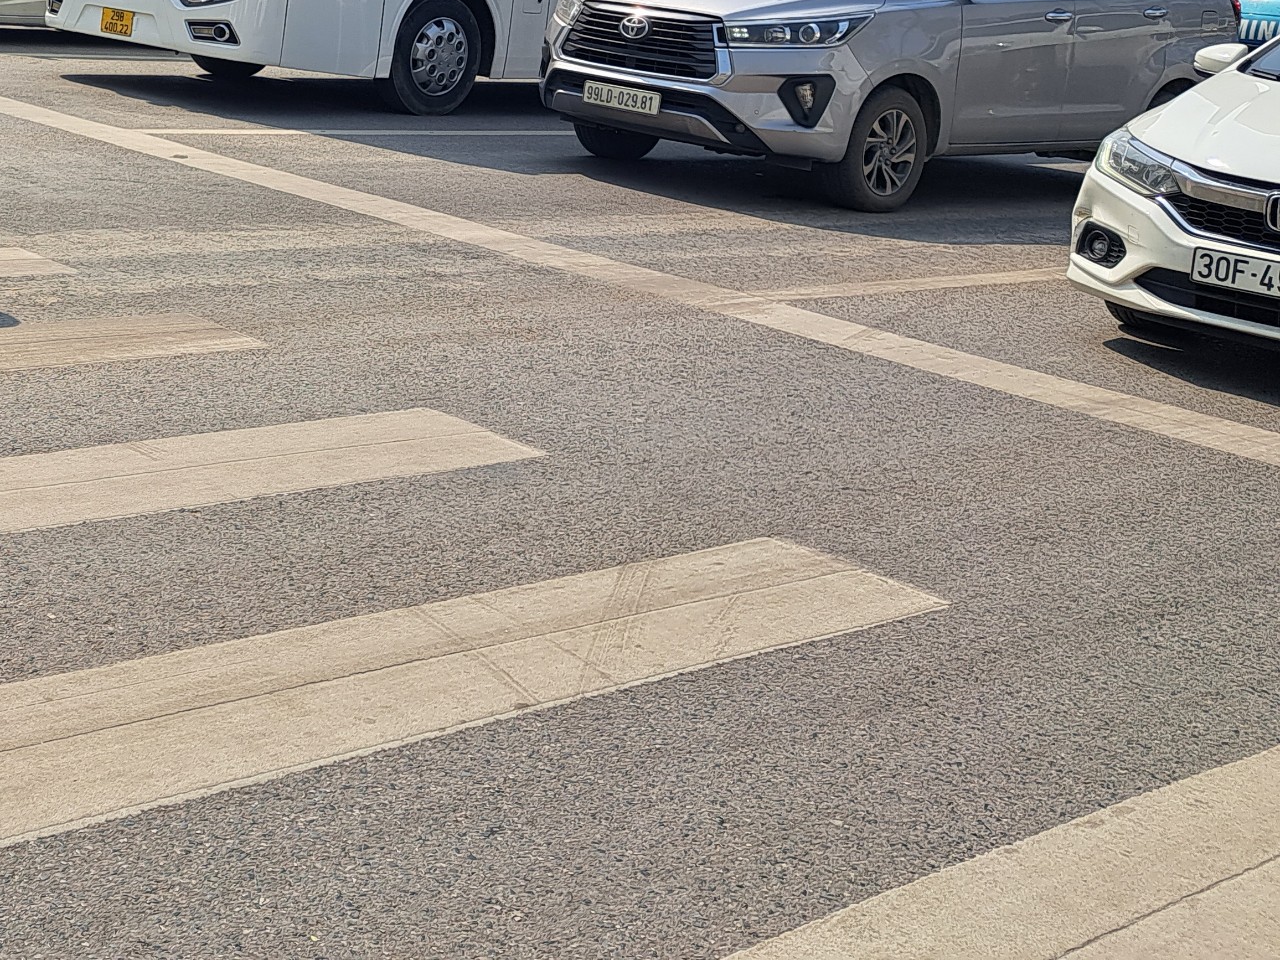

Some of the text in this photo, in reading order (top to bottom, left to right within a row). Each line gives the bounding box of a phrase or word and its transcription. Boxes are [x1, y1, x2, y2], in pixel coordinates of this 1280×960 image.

[110, 10, 125, 22] 29B
[104, 22, 129, 35] 400.22
[586, 86, 654, 112] 99LD-029.81
[1197, 252, 1280, 292] 30F-4
